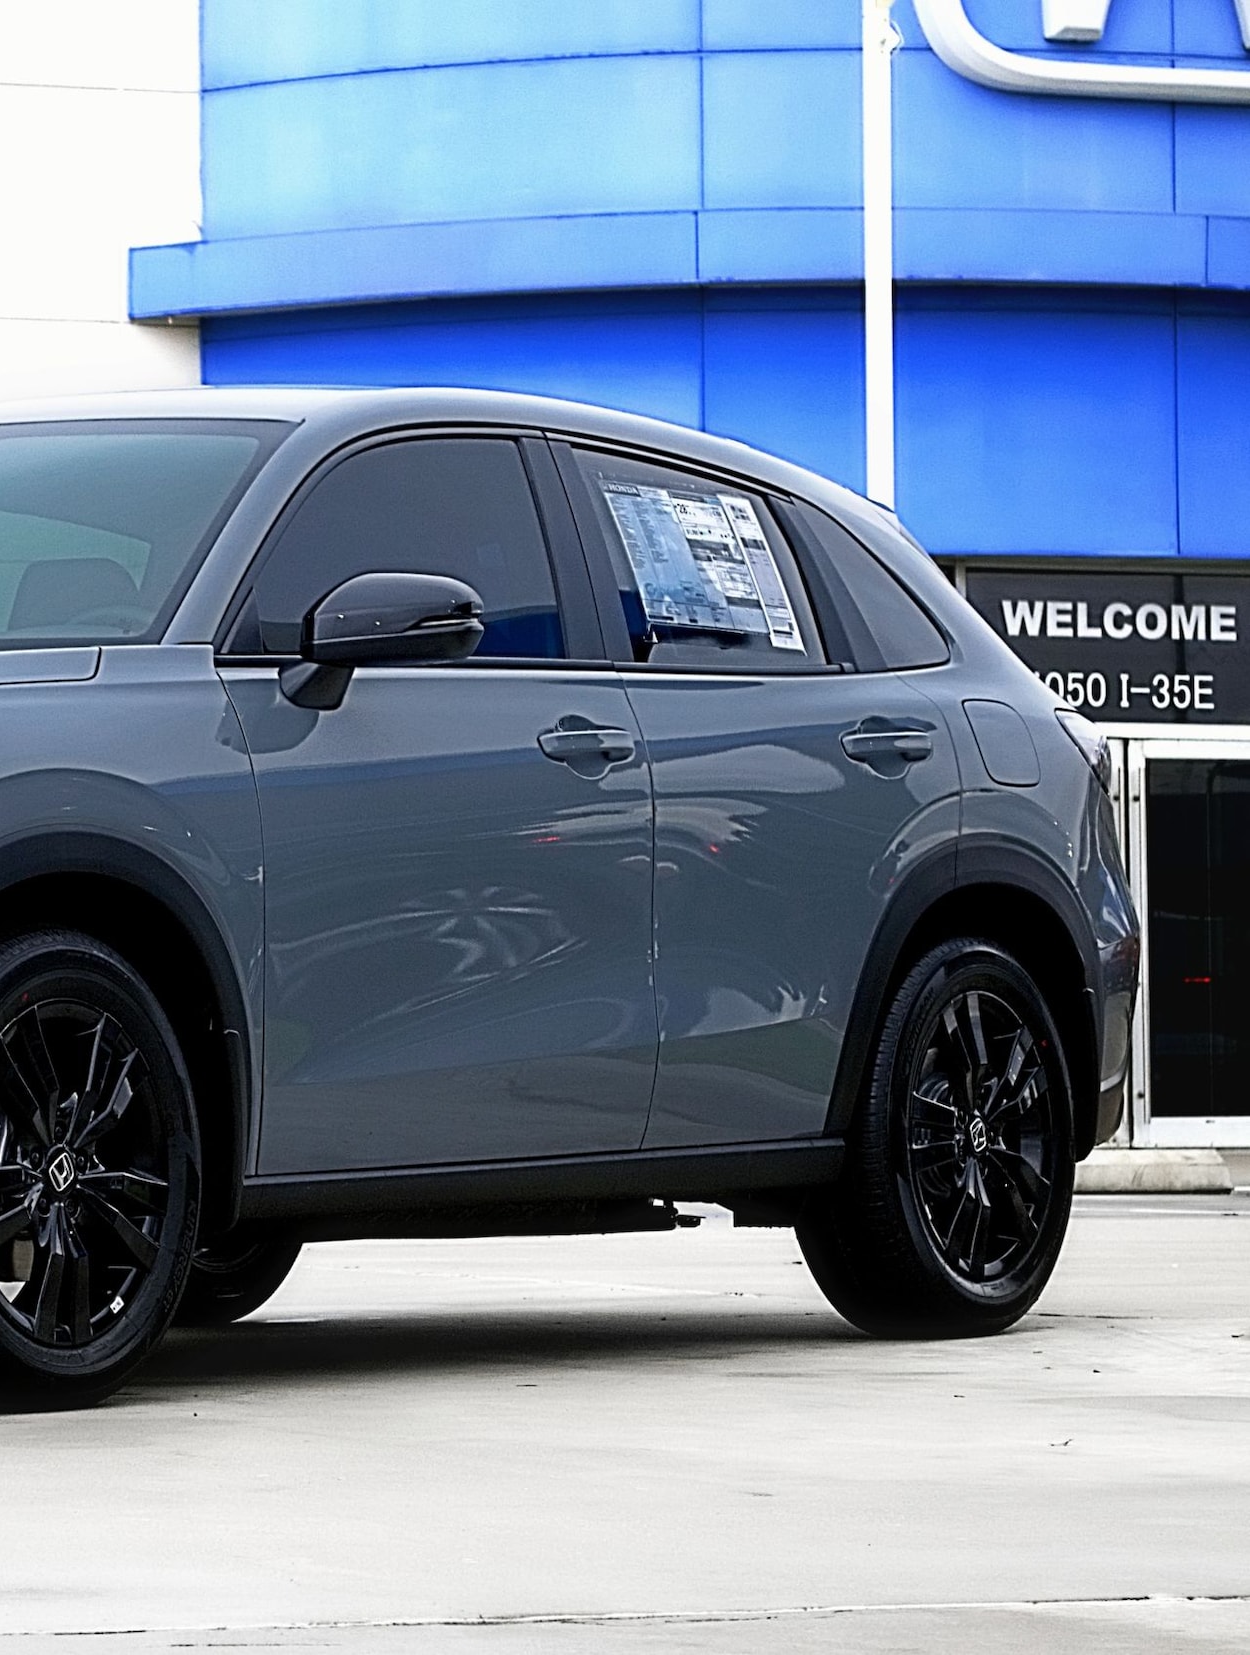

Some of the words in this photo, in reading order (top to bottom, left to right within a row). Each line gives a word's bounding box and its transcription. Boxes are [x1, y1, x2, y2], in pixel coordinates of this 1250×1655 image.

[1002, 600, 1237, 641] WELCOME
[1036, 671, 1107, 708] 050
[1119, 673, 1215, 709] I-35E
